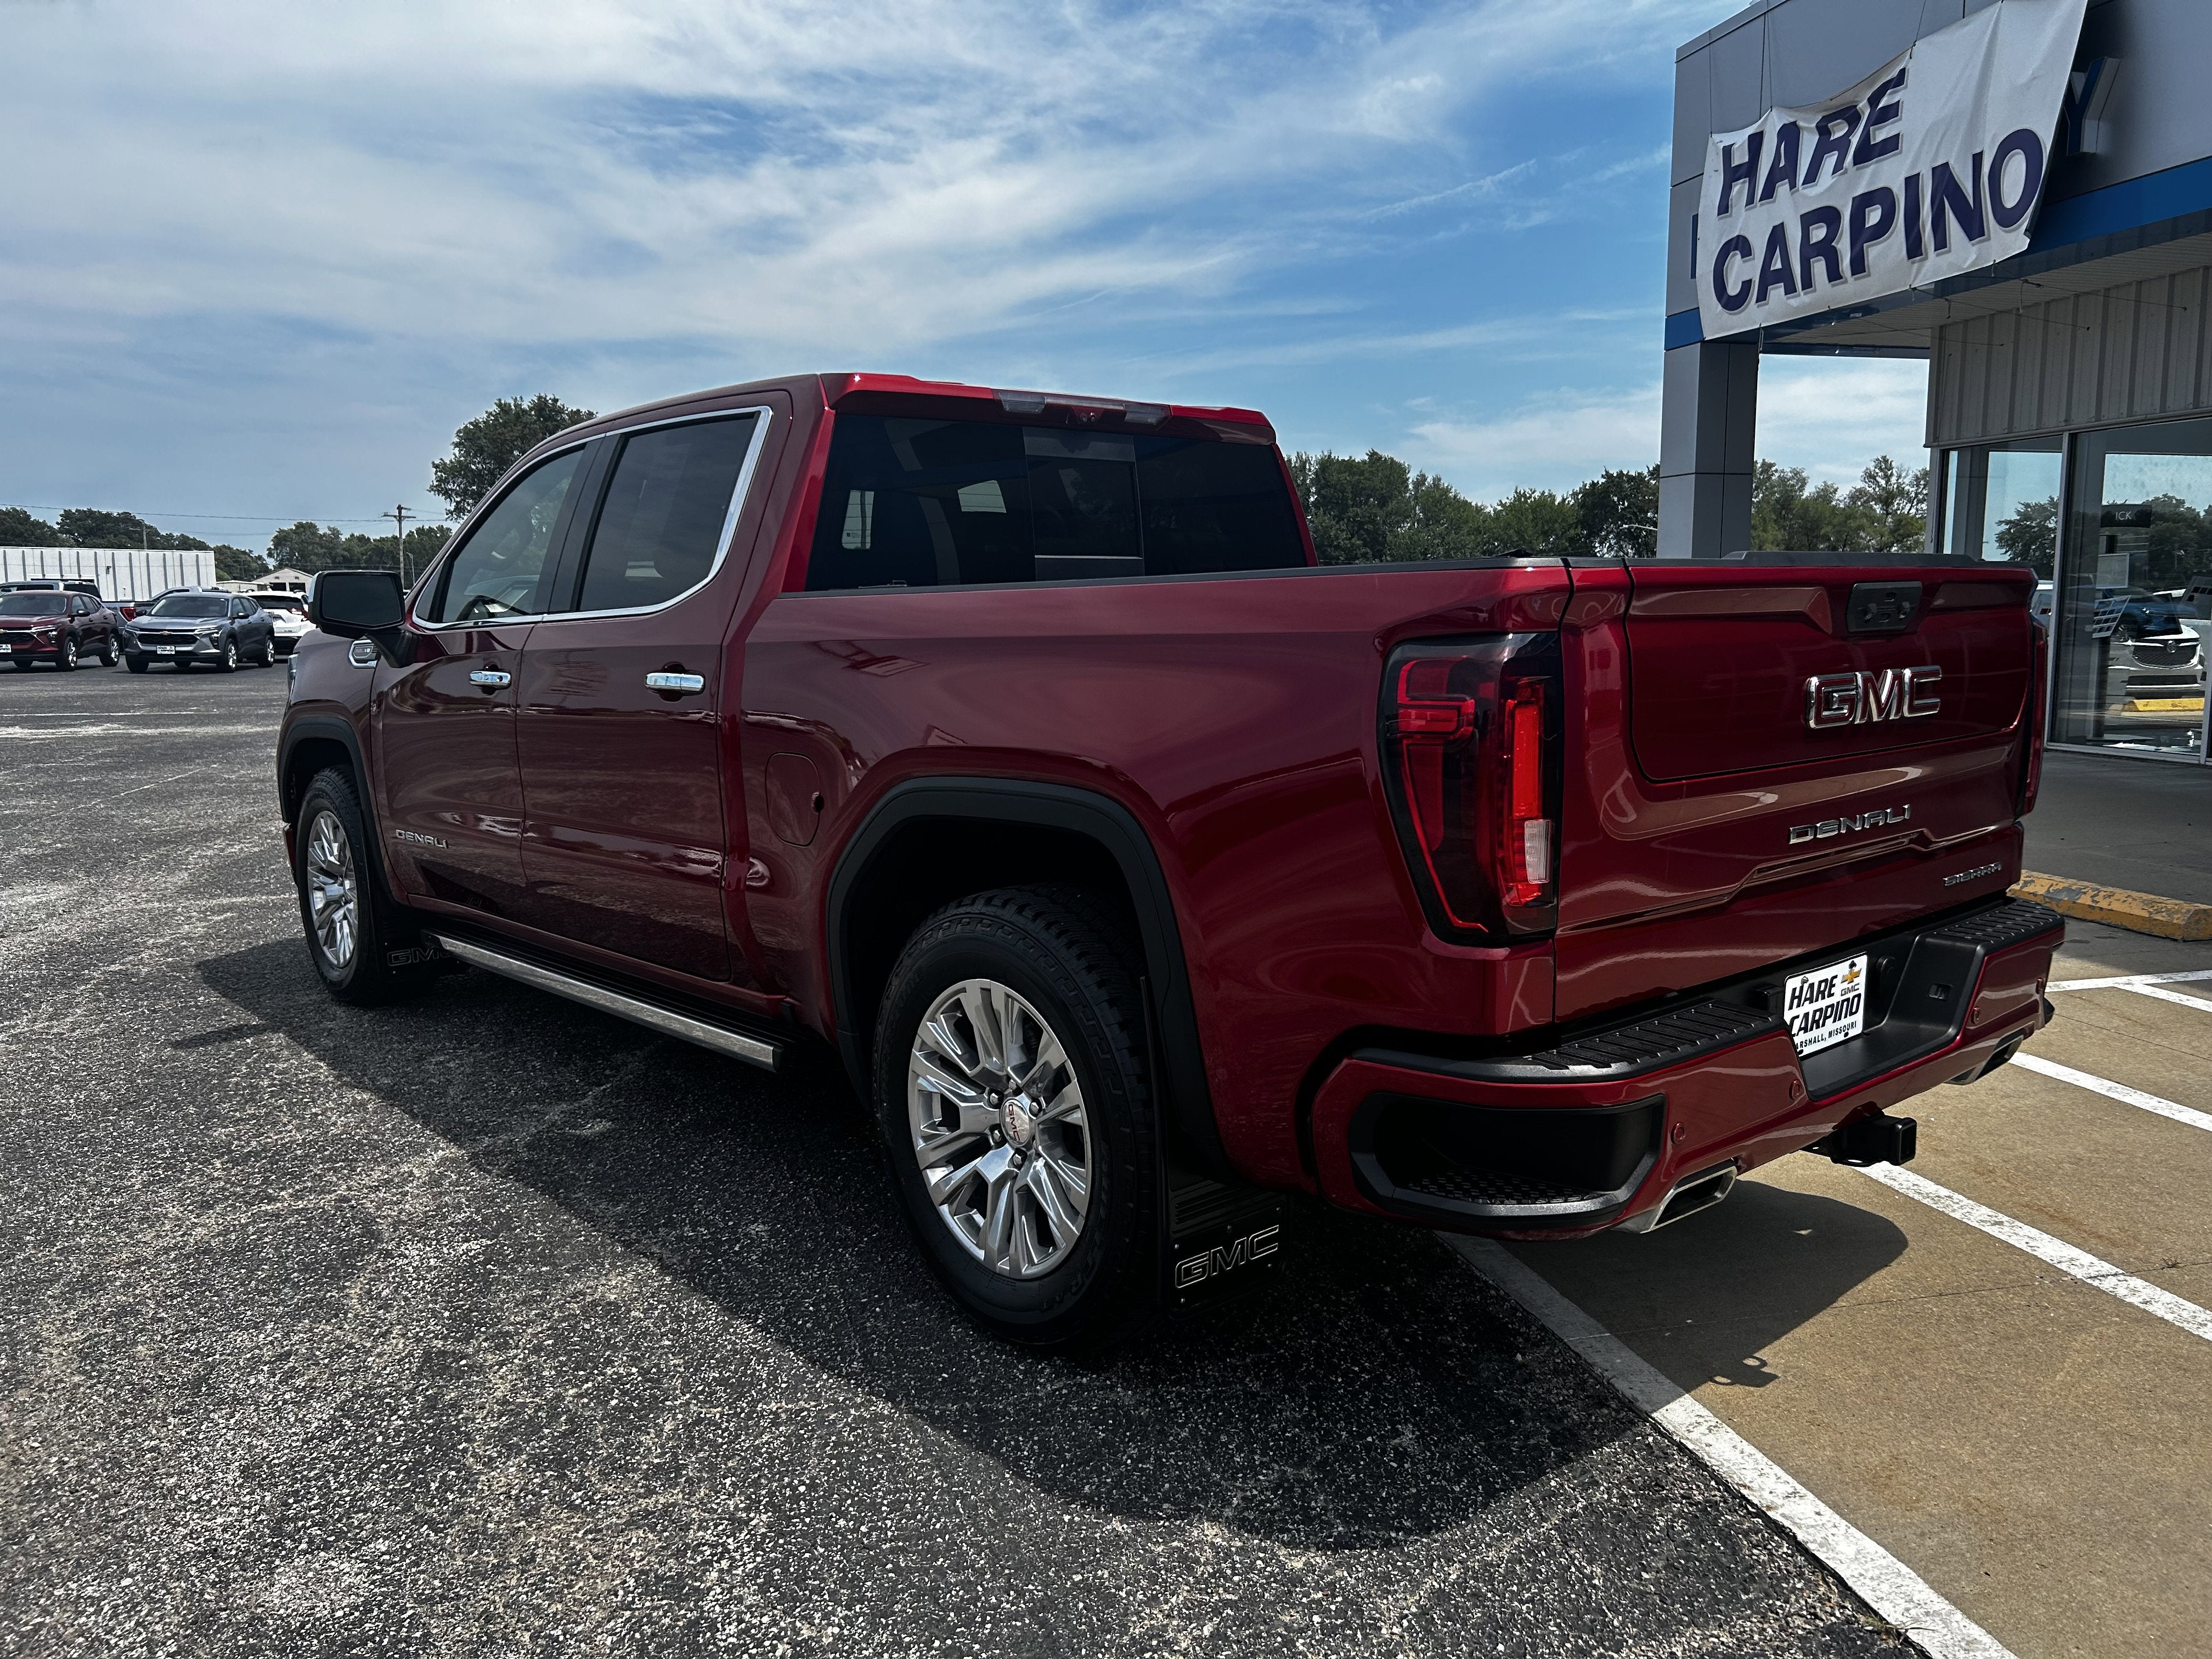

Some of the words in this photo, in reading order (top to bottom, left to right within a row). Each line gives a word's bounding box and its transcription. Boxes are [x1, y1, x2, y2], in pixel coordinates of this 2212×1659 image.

[1718, 66, 1908, 217] HARE
[1712, 127, 2045, 312] CARPINO
[1804, 665, 1942, 729] GMC
[396, 830, 449, 848] DENALI
[1788, 804, 1911, 844] DENALI
[1943, 862, 2002, 886] SIERRA
[1788, 975, 1838, 1011] HARE
[1841, 983, 1860, 996] GMC
[1789, 992, 1861, 1037] CARPINO
[1796, 1034, 1826, 1049] ARSHALL,
[1829, 1021, 1857, 1037] MISSOURI
[1008, 1104, 1020, 1141] GMC
[1175, 1224, 1279, 1288] GMC
